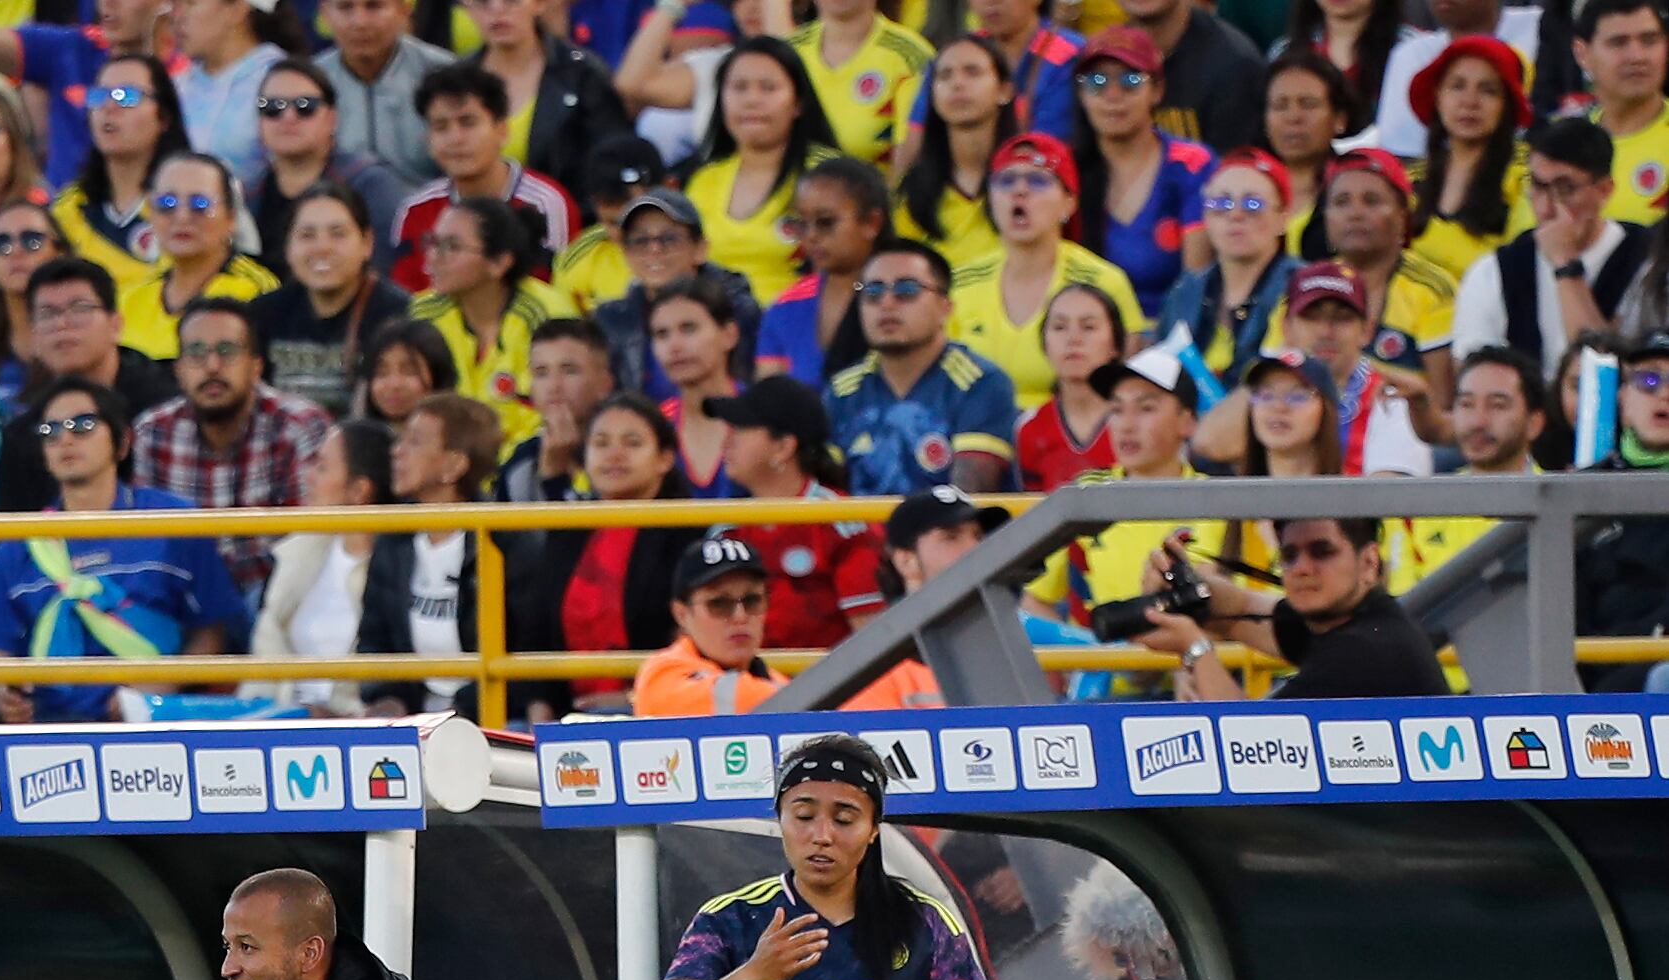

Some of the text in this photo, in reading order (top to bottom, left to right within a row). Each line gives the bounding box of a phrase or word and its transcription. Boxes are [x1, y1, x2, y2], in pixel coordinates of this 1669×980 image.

[702, 539, 750, 564] 911
[1142, 733, 1203, 779] AGUILA
[1230, 739, 1309, 769] BetPlay
[1329, 755, 1394, 769] Bancolombia
[24, 761, 82, 805] AGUILA
[110, 767, 184, 798] BetPlay
[201, 784, 261, 797] Bancolombia
